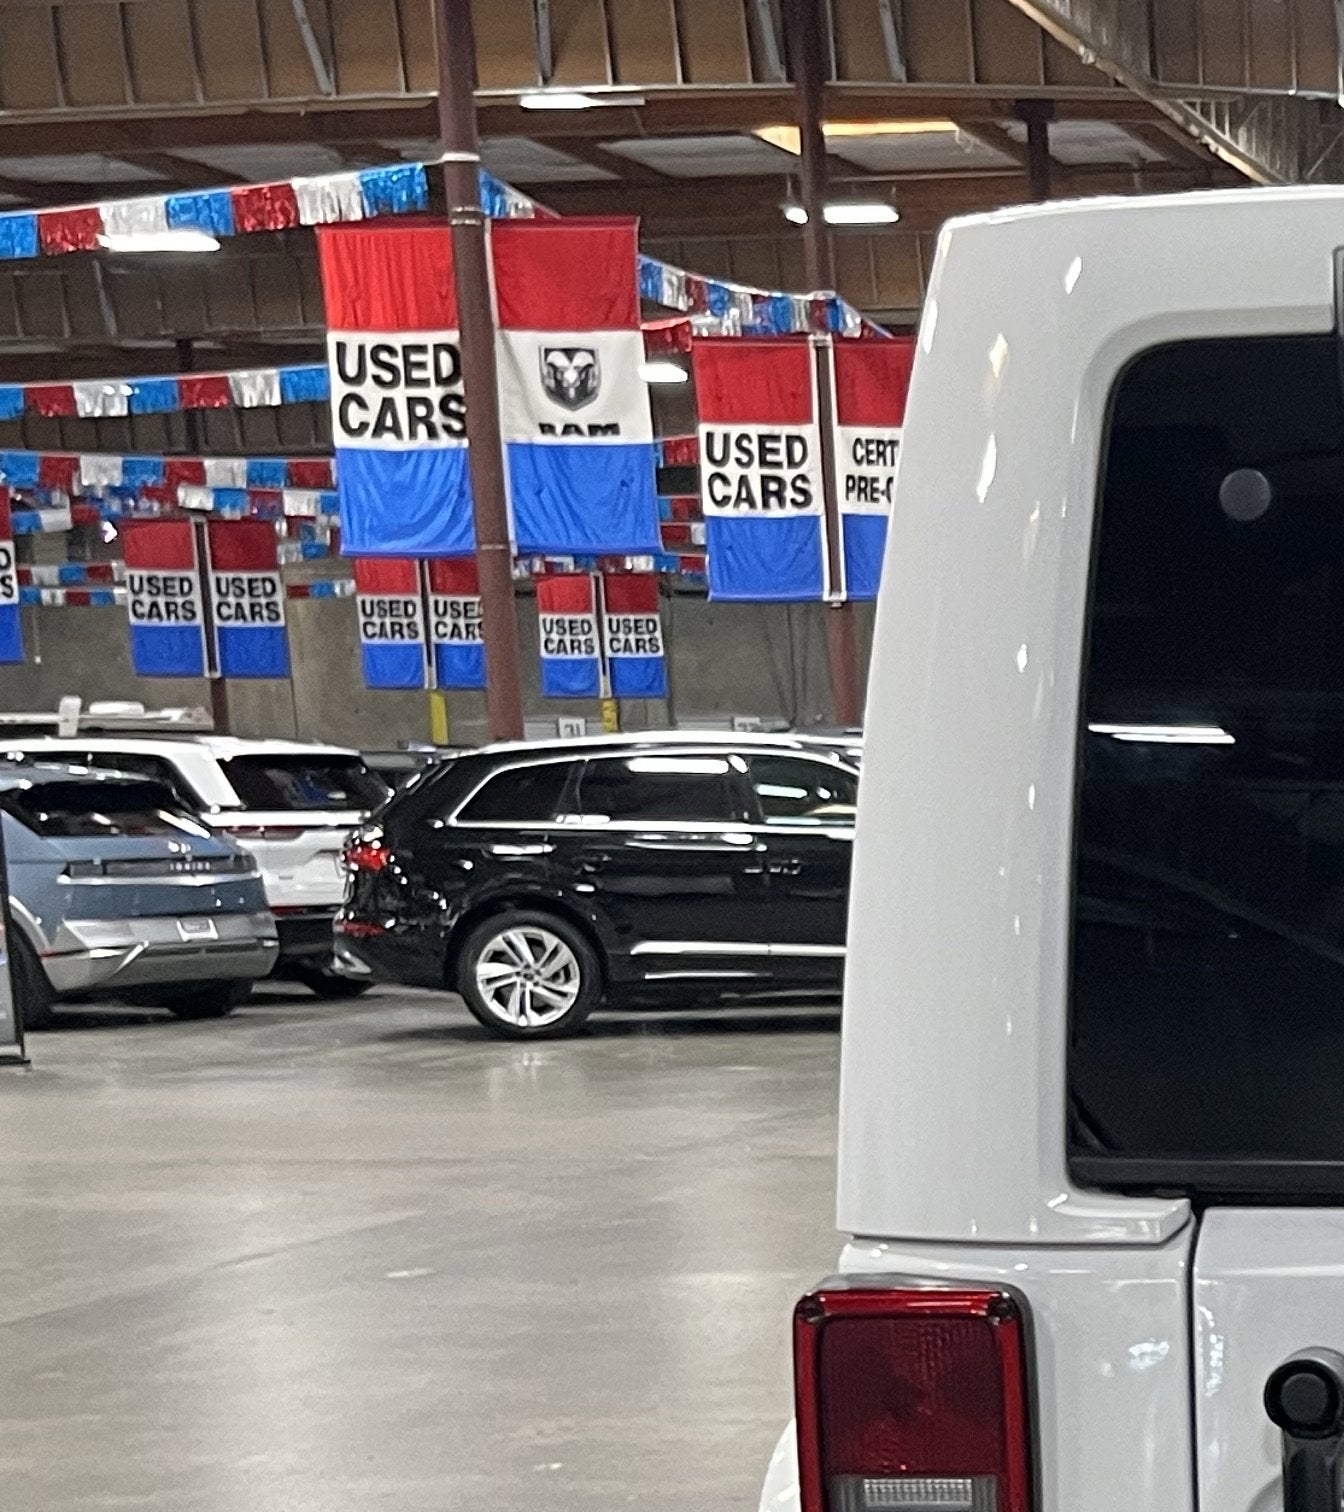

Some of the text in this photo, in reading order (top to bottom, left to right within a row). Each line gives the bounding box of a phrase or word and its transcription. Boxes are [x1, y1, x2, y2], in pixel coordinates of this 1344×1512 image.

[335, 341, 463, 389] USED
[338, 391, 467, 441] CARS
[705, 431, 809, 470] USED
[707, 471, 814, 510] CARS
[129, 574, 193, 598] USED
[215, 576, 277, 598] USED
[131, 599, 197, 622] CARS
[216, 600, 281, 623] CARS
[361, 599, 417, 619] USED
[362, 620, 419, 640] CARS
[543, 617, 593, 636] USED
[608, 617, 658, 636] USED
[544, 637, 595, 656] CARS
[609, 636, 660, 655] CARS
